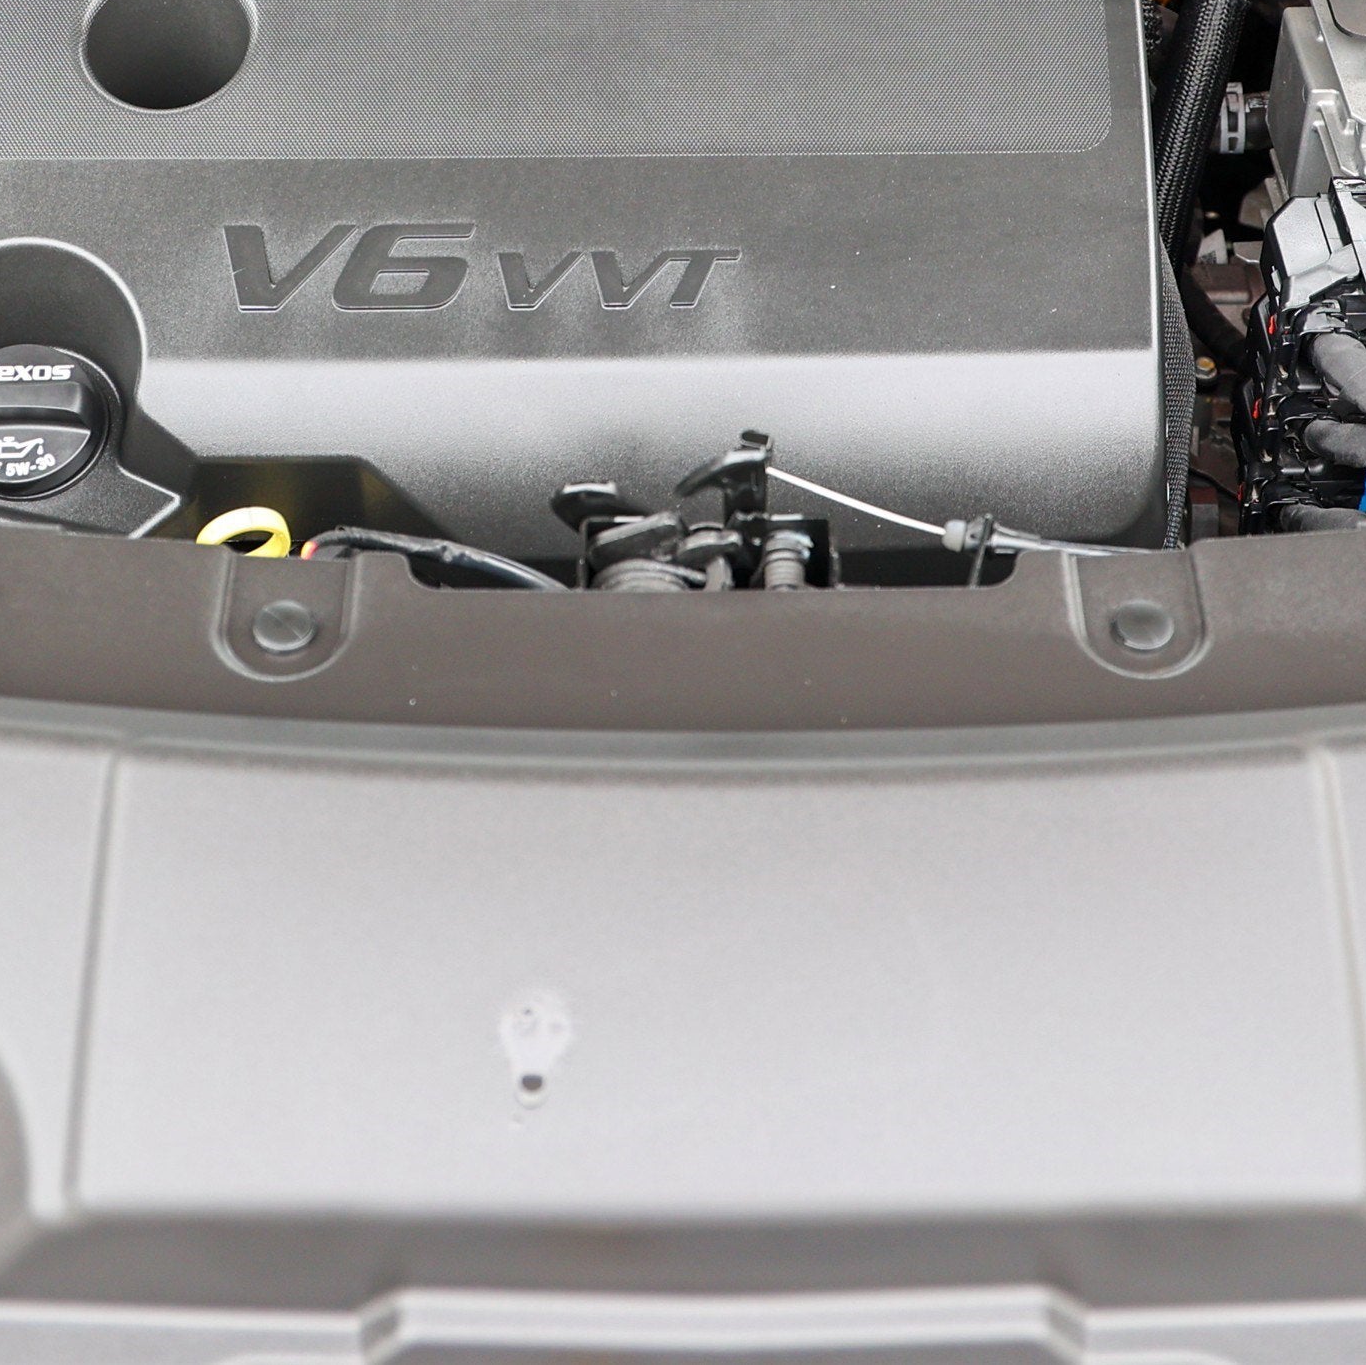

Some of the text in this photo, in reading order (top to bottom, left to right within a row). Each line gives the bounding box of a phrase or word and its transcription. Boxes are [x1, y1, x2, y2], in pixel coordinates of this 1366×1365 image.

[223, 222, 741, 312] V6 VVT
[5, 453, 56, 477] 5W-30
